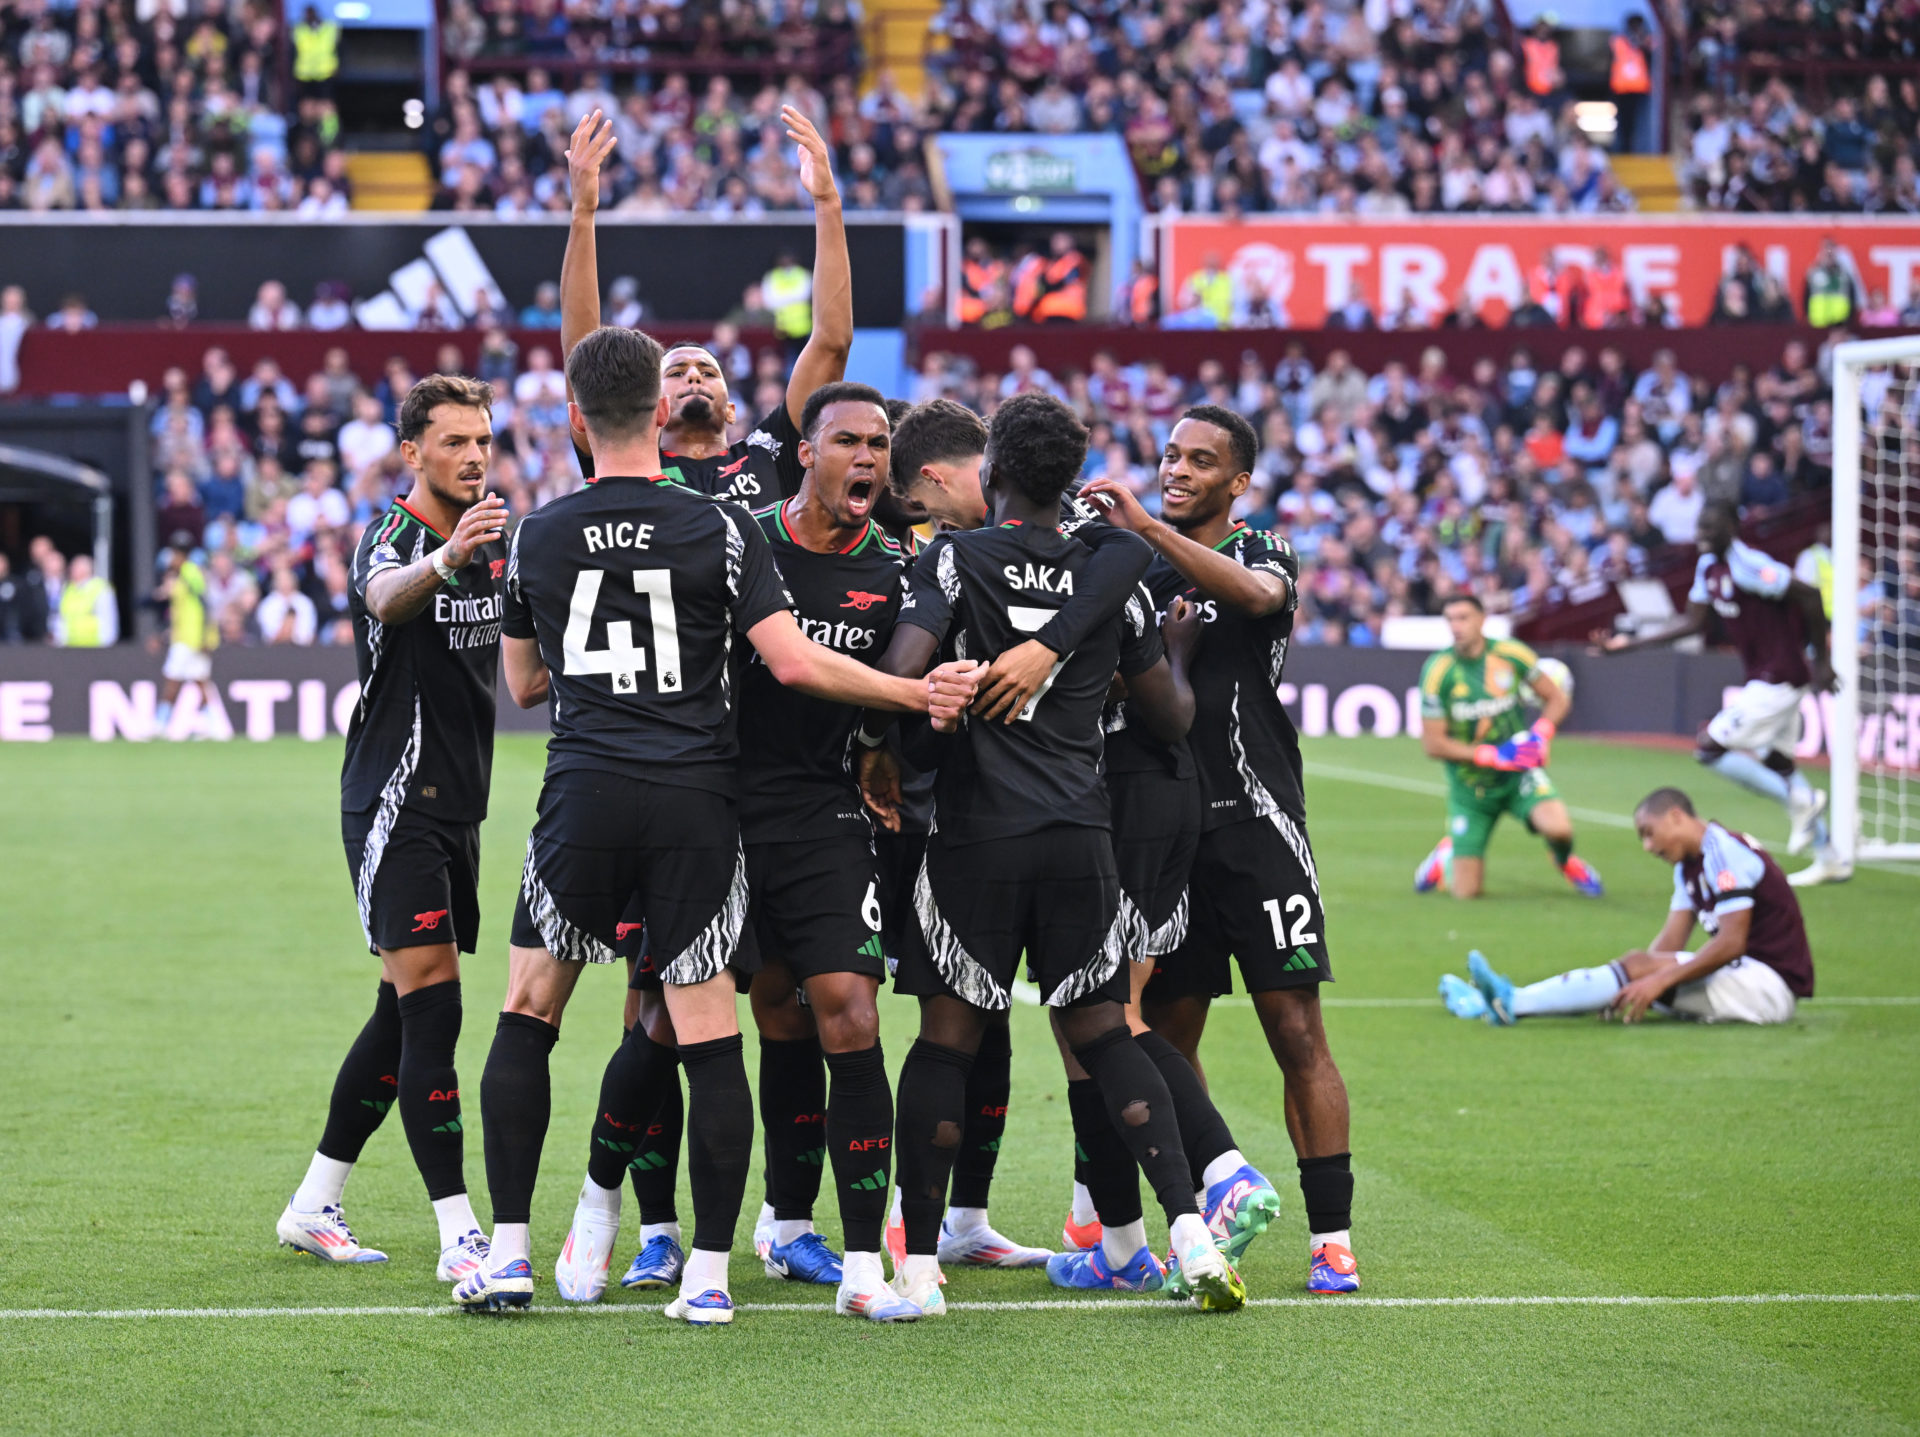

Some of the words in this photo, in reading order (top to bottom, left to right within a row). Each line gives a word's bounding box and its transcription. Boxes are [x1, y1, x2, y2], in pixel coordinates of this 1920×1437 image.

[583, 522, 655, 553] RICE
[1003, 562, 1074, 596] SAKA
[562, 568, 683, 695] 41
[791, 609, 877, 650] irates
[860, 880, 882, 932] 6
[1262, 893, 1319, 950] 12
[849, 1136, 890, 1152] AFC
